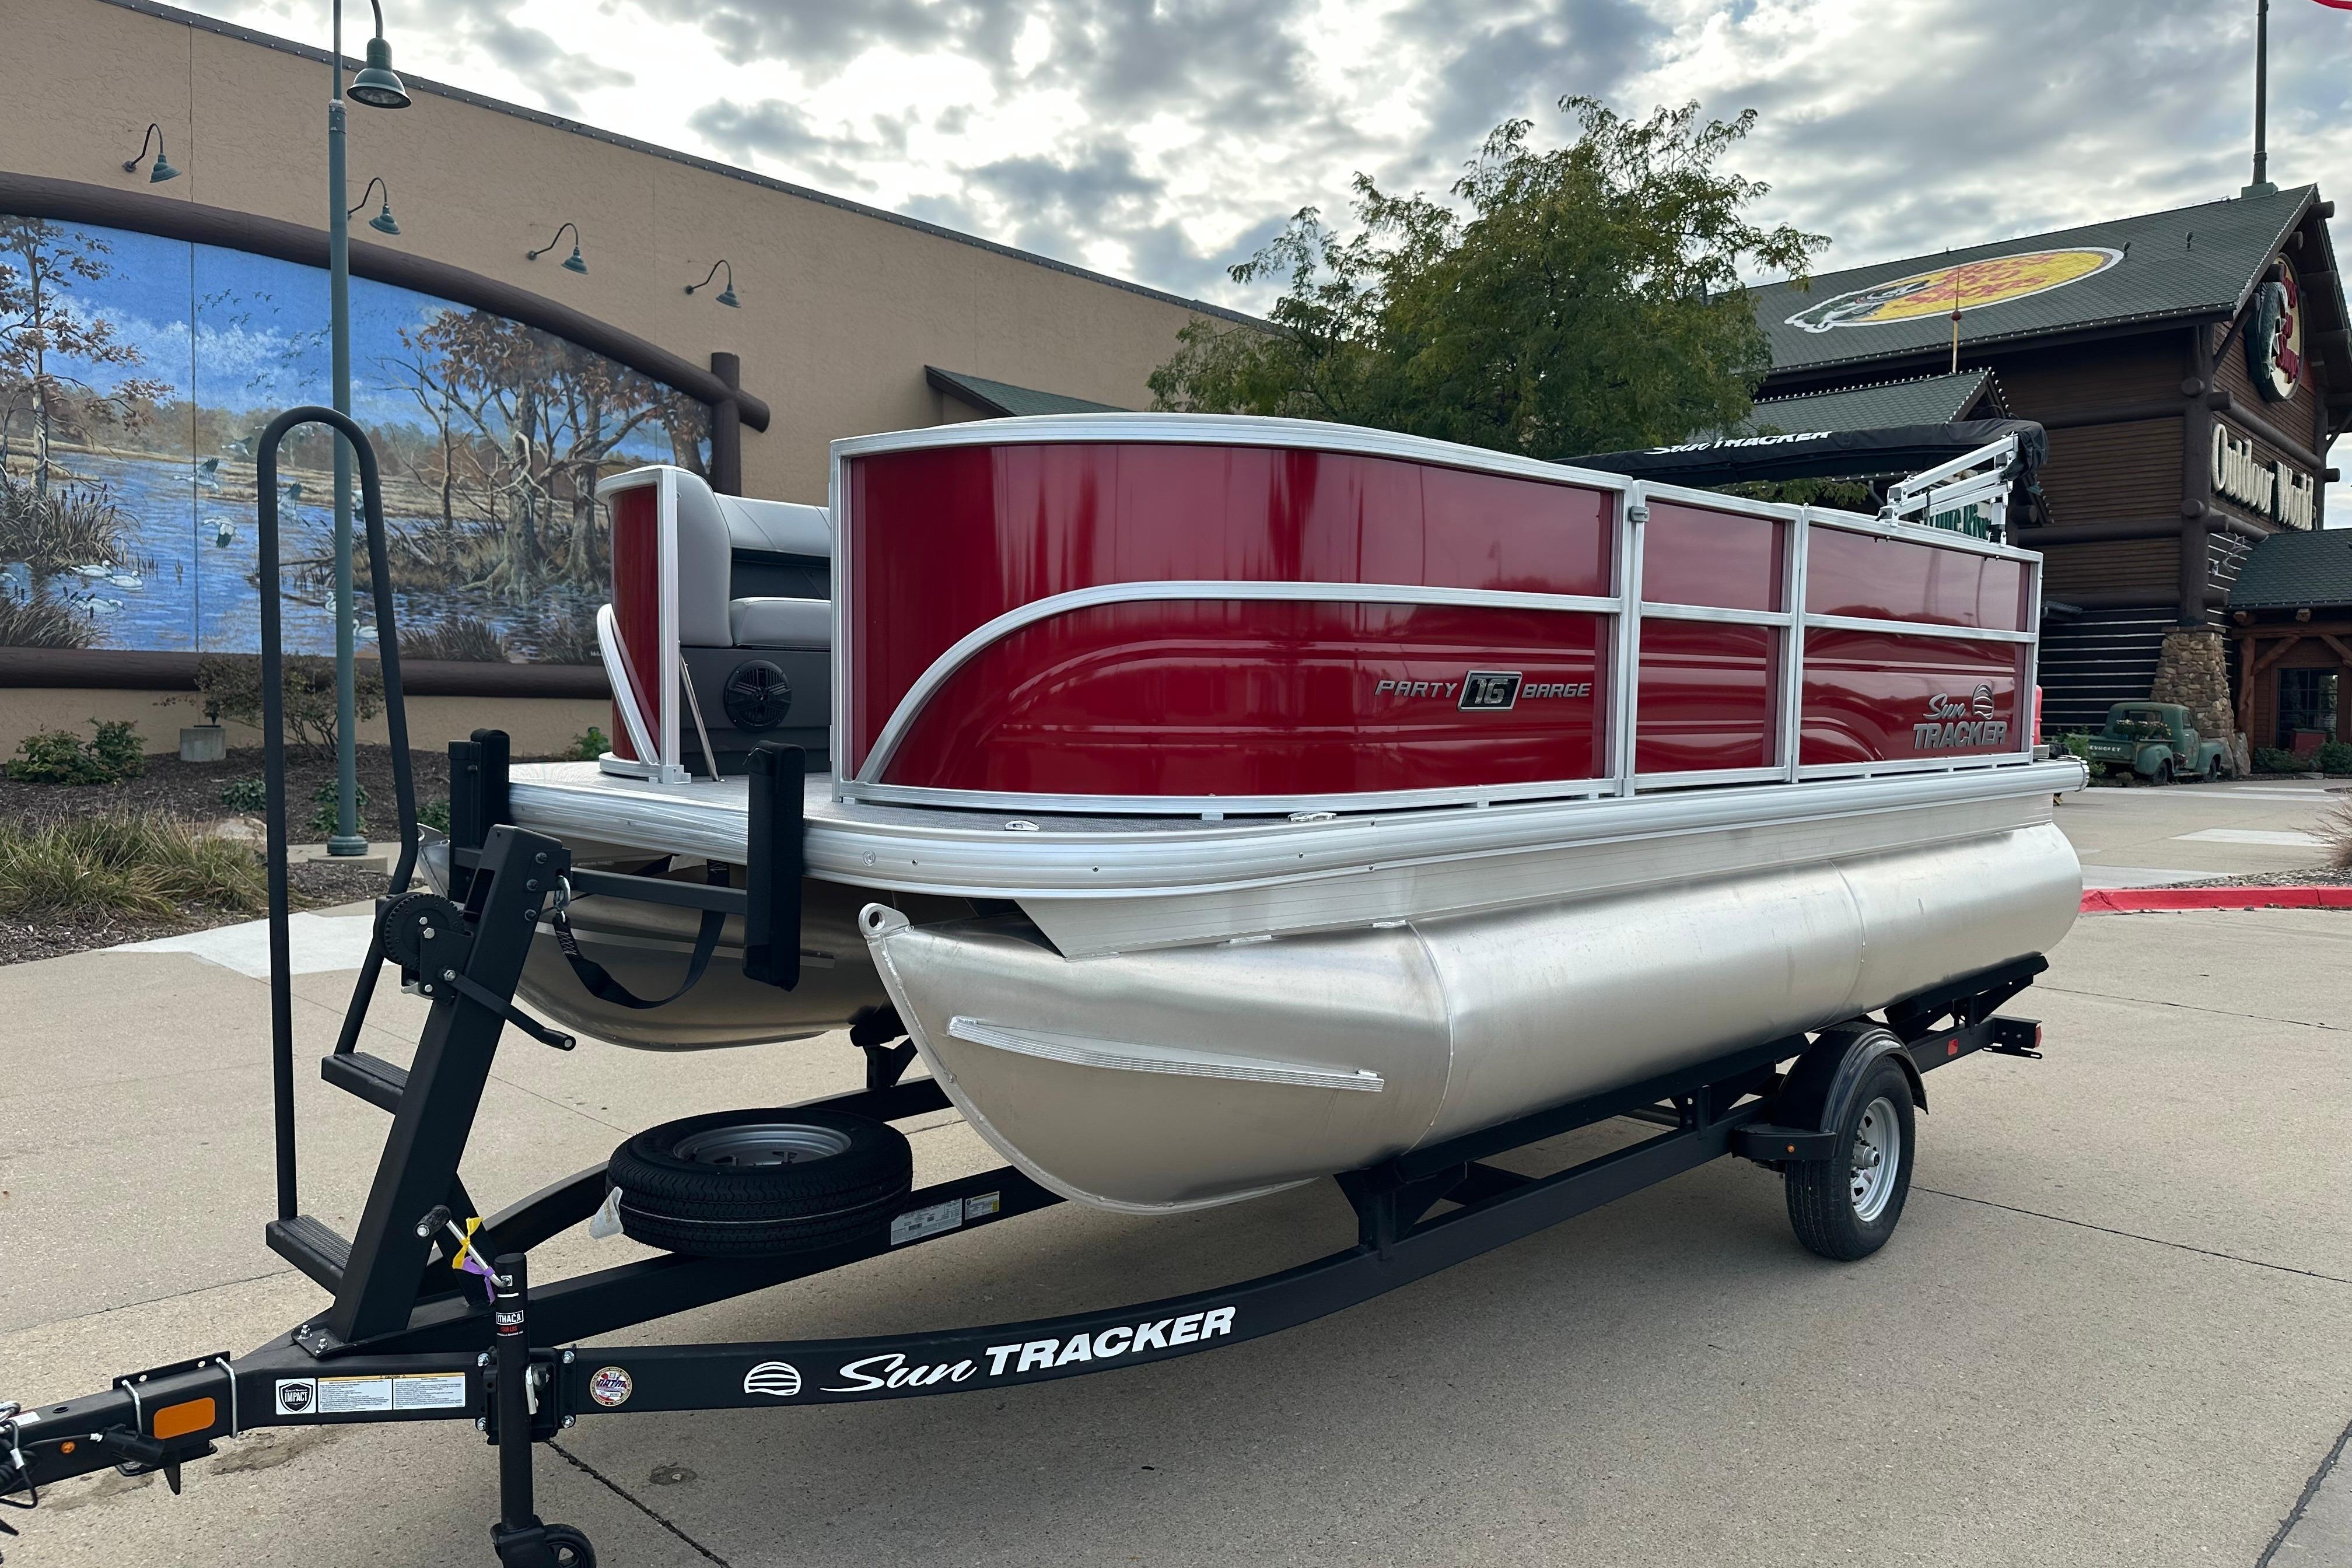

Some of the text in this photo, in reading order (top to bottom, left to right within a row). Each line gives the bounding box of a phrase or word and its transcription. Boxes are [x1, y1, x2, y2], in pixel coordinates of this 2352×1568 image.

[2211, 423, 2314, 531] Outdoor World
[1374, 678, 1592, 705] PARTY 16 BARGE
[1923, 693, 1966, 720] Sun
[1913, 721, 2008, 750] TRACKER
[497, 1312, 521, 1323] ITHACA
[820, 1306, 1237, 1392] Sun TRACKER
[285, 1391, 308, 1402] IMPACT
